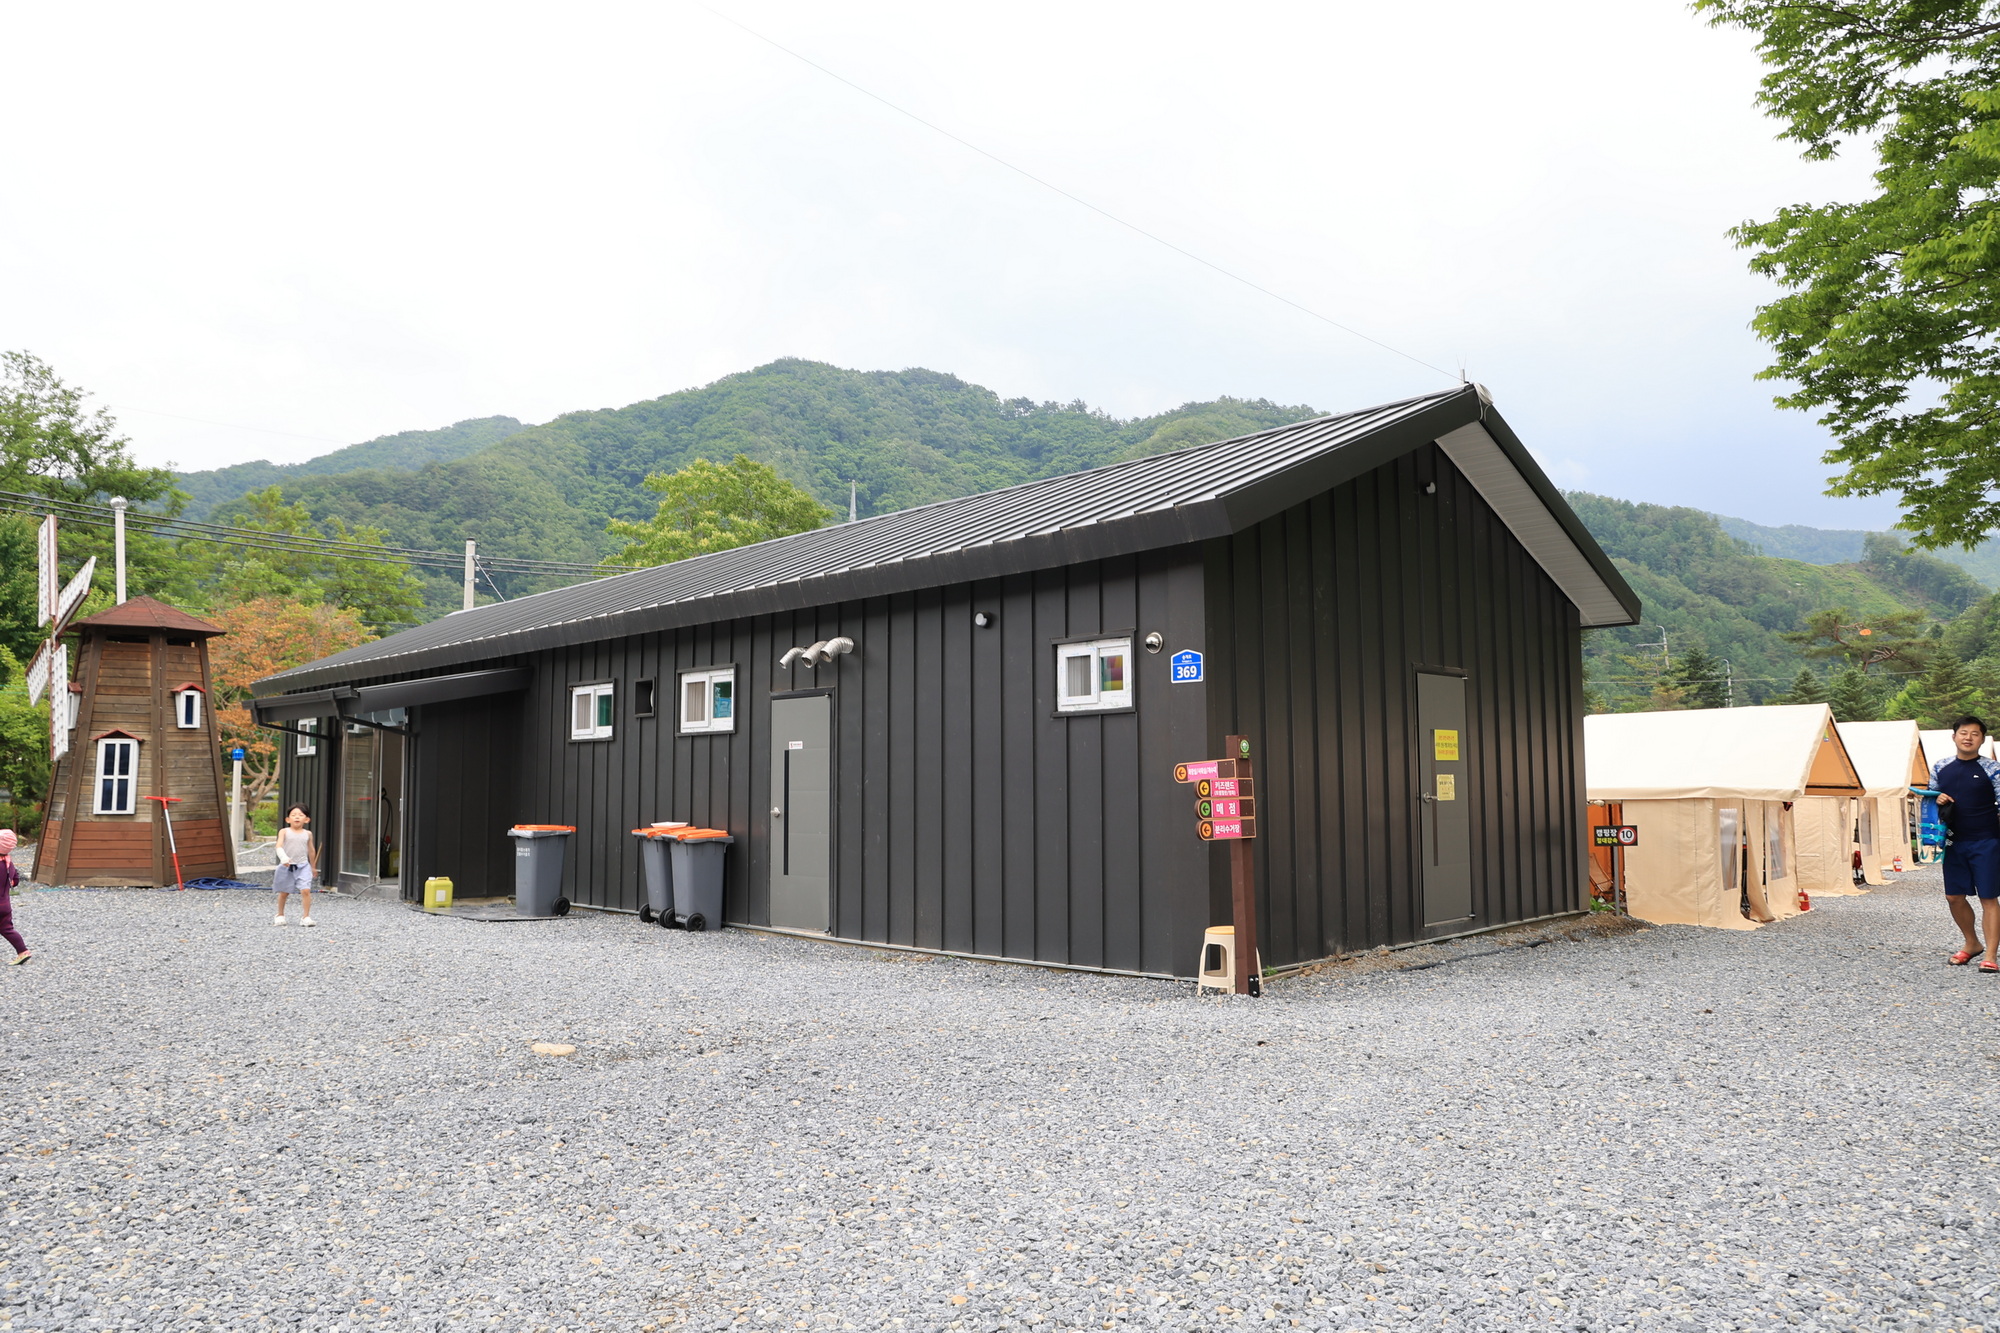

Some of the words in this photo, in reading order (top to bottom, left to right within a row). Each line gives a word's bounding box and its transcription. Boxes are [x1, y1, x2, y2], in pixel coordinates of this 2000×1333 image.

[1177, 665, 1197, 678] 369
[1215, 824, 1240, 834] 분리수거장
[1596, 829, 1617, 837] 캠핑장
[1621, 830, 1633, 839] 10
